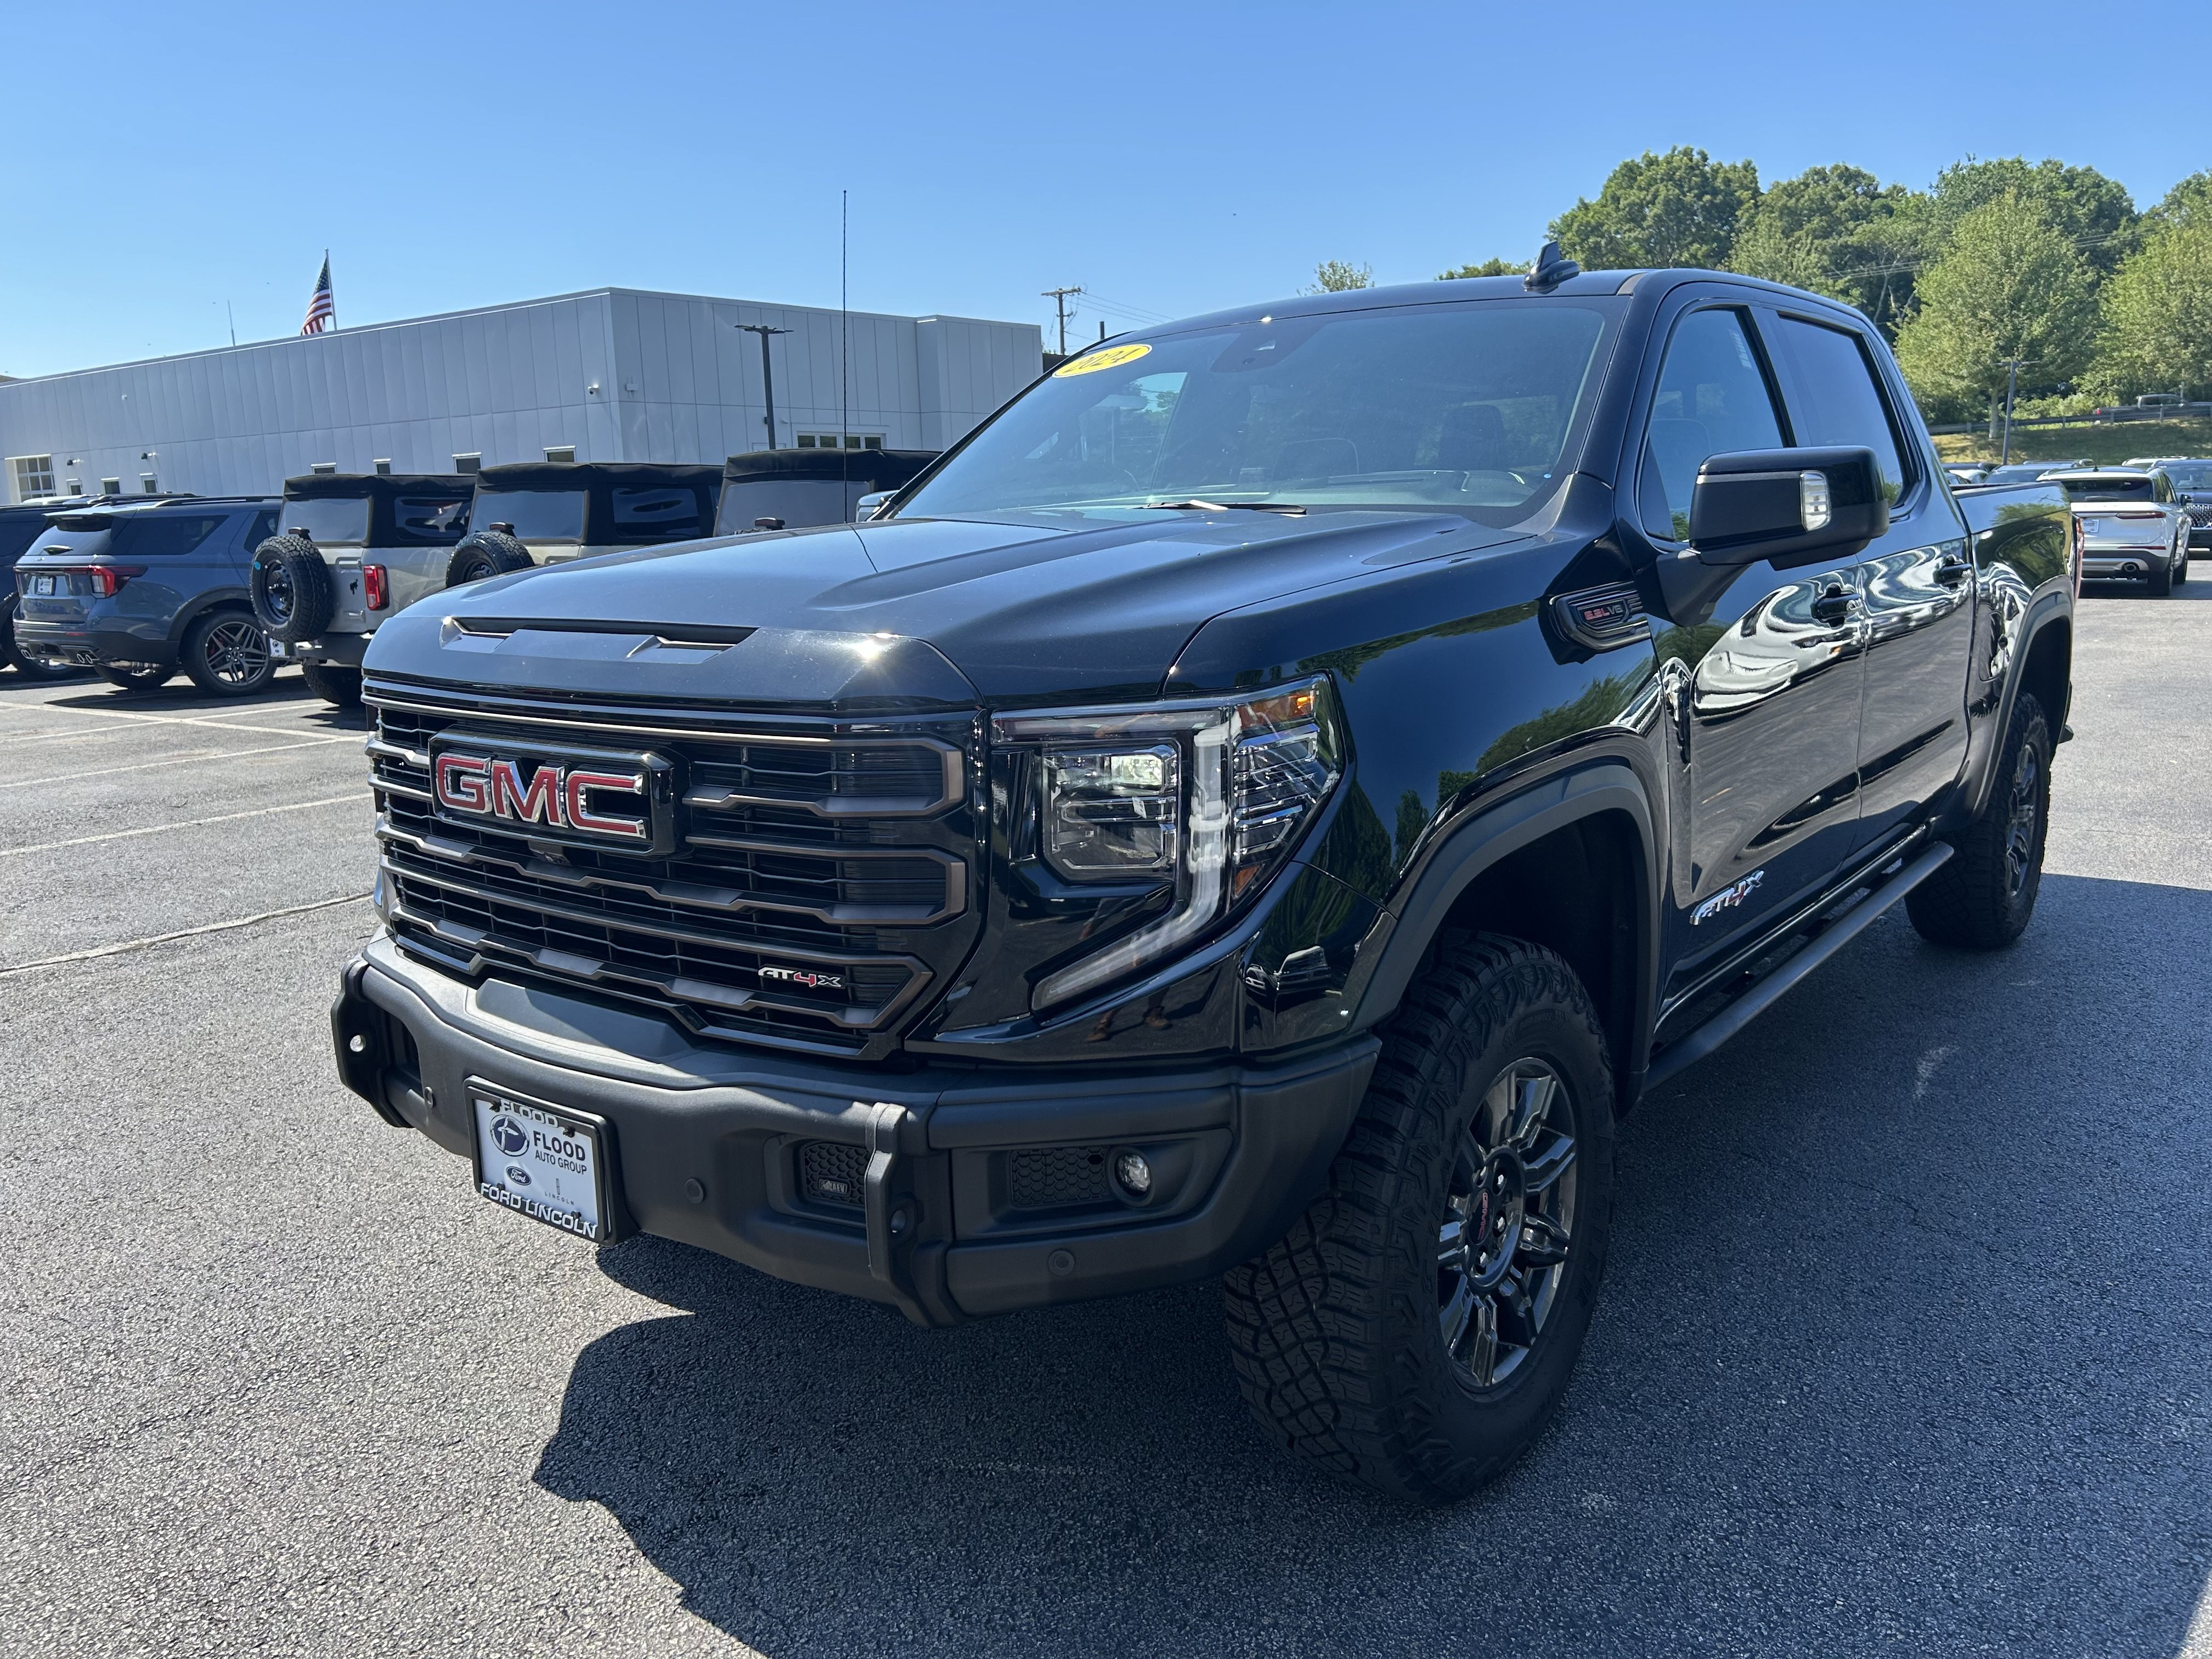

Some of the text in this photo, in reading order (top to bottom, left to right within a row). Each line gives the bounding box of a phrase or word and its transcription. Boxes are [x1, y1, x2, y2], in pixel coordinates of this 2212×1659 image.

[1062, 348, 1142, 374] 2024
[436, 752, 647, 839] GMC
[1690, 870, 1764, 926] AT4X
[758, 967, 842, 988] AT4X
[500, 1099, 558, 1128] FLOOD
[533, 1130, 585, 1161] FLOOD
[510, 1169, 527, 1183] Ford
[535, 1150, 587, 1175] AUTO GROUP
[481, 1182, 598, 1239] FORD LINCOLN
[544, 1192, 574, 1205] LINCOLN
[1477, 1192, 1488, 1240] GMC
